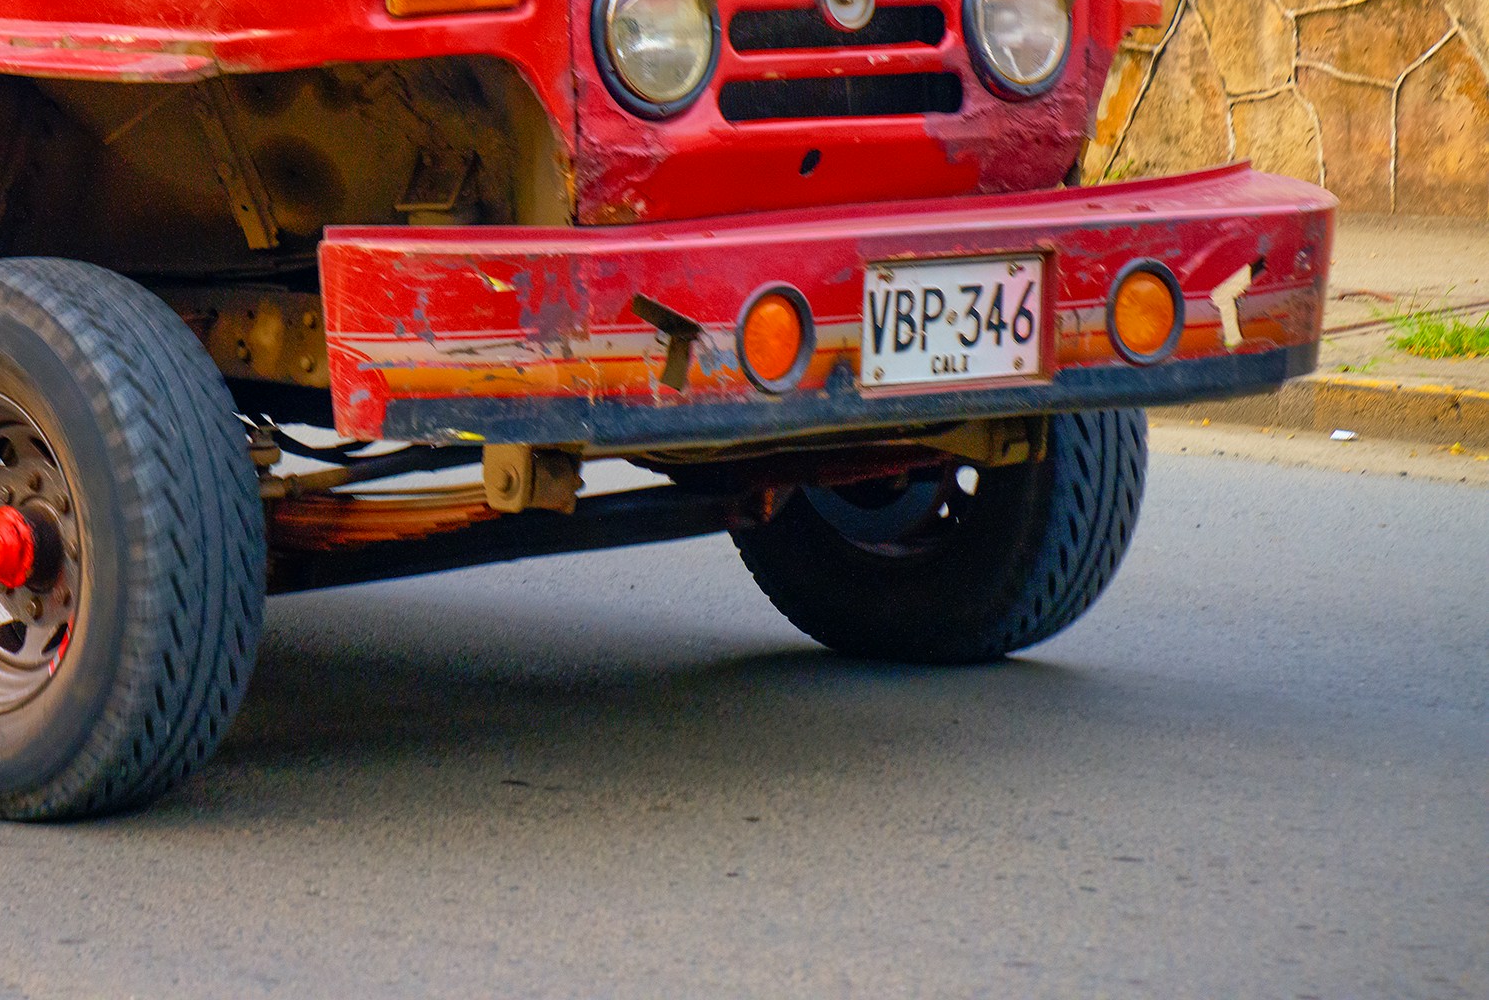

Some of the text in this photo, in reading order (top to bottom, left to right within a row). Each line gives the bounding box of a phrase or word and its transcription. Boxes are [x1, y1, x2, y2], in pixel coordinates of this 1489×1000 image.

[868, 280, 1036, 355] VBP 346
[931, 353, 971, 375] CALI
